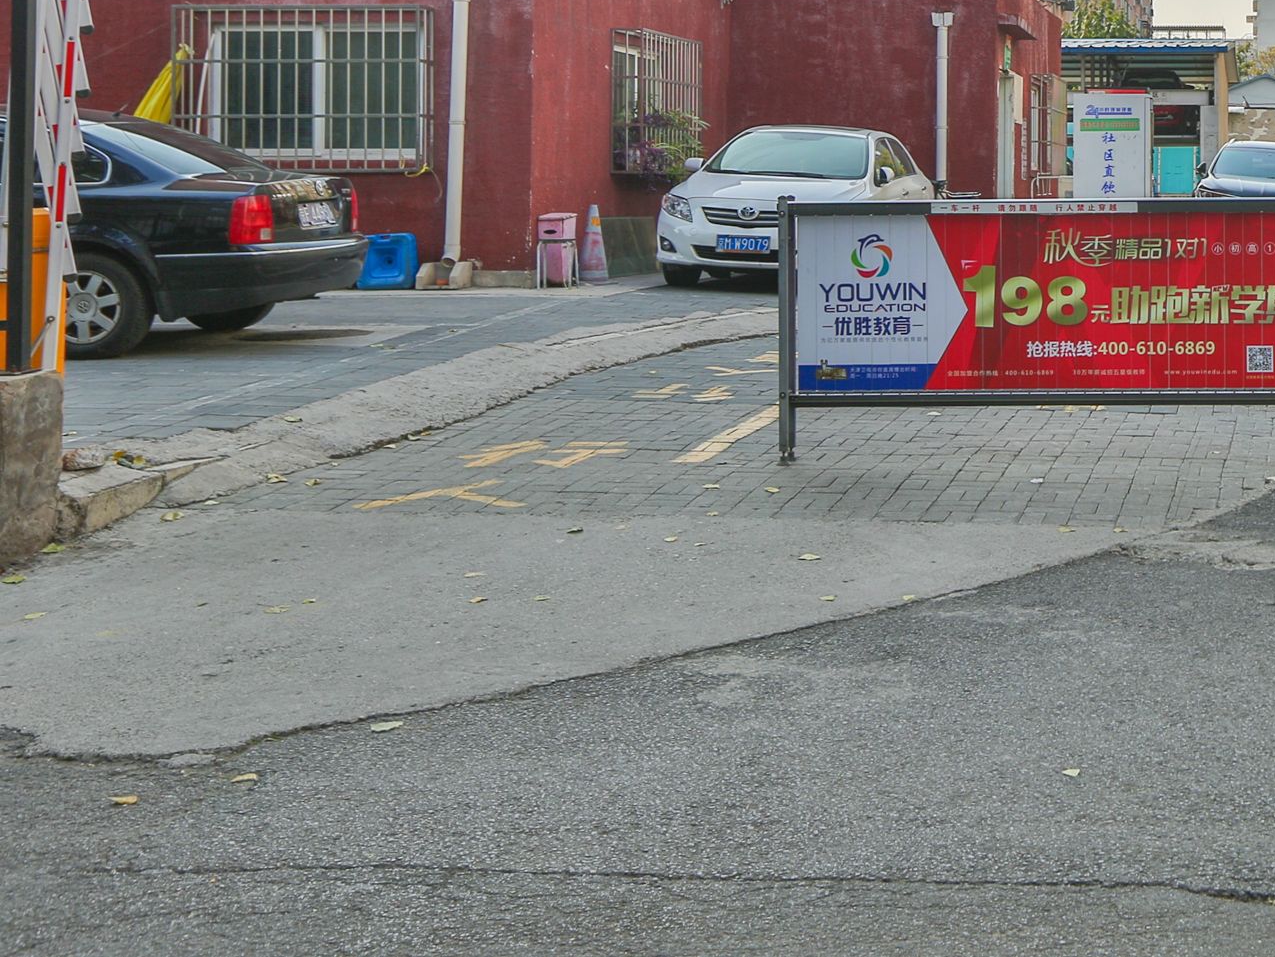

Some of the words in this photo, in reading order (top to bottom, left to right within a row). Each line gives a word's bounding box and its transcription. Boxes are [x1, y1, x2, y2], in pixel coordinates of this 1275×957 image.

[940, 204, 981, 212] 一车一杆
[819, 282, 926, 303] YOUWIN
[824, 303, 926, 313] EDUCATION
[834, 316, 911, 336] 优胜教育
